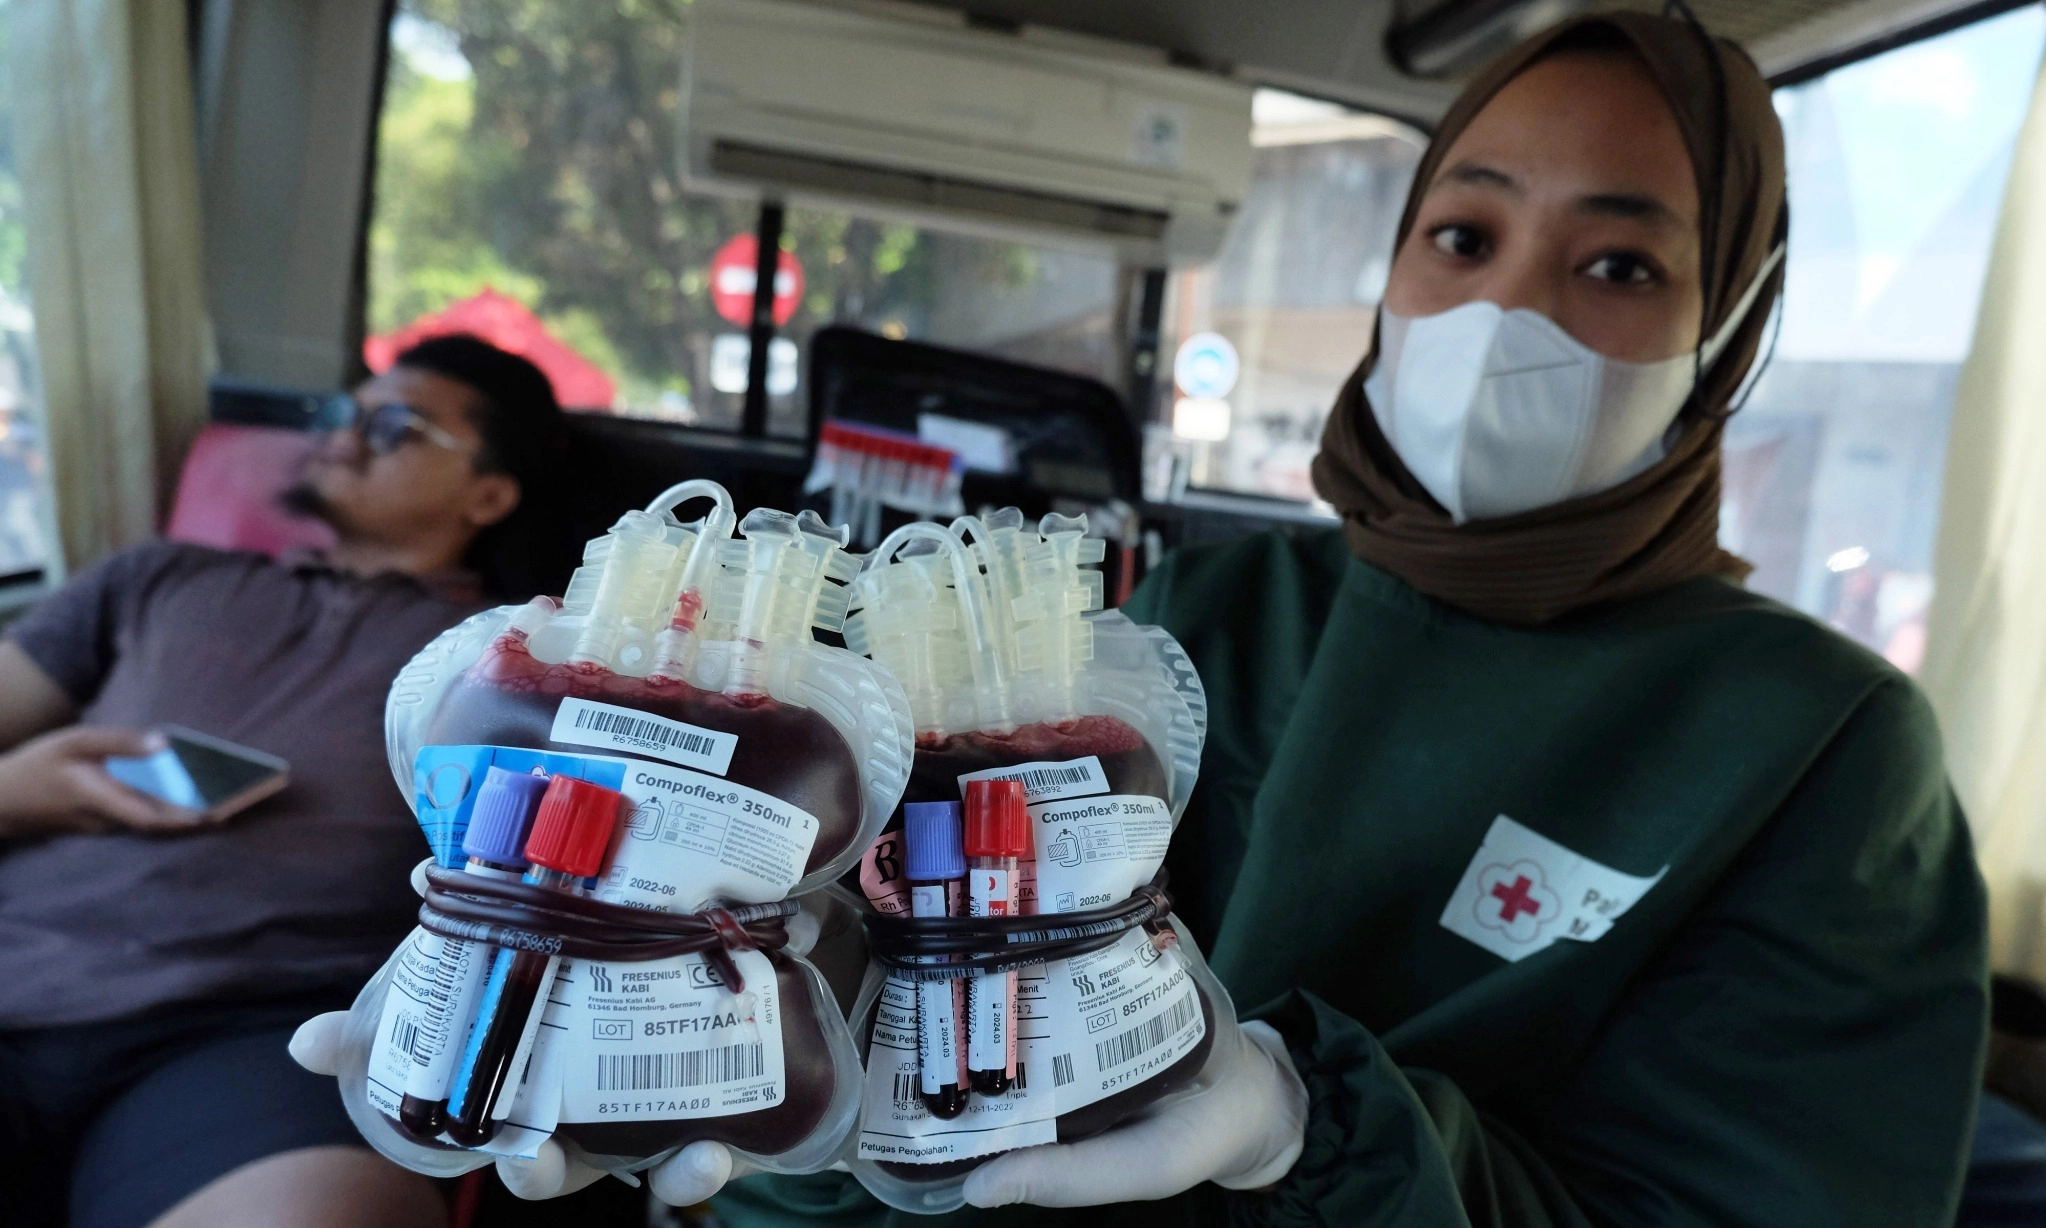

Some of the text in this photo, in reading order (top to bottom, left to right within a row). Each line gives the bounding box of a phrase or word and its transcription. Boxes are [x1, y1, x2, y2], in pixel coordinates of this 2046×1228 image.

[612, 735, 667, 752] R6758659
[425, 762, 472, 809] O
[1024, 786, 1062, 797] 6763892
[742, 800, 792, 828] 350ml
[1123, 803, 1155, 815] 350ml
[802, 819, 809, 829] 1
[874, 839, 900, 886] B
[629, 878, 676, 896] 2022-06
[880, 899, 897, 912] Rh
[1080, 894, 1111, 907] 2022-06
[989, 907, 1003, 916] tor
[500, 928, 562, 954] R6758659
[454, 950, 472, 983] KOTA
[1099, 957, 1135, 981] FRESENIUS
[622, 970, 681, 982] FRESENIUS
[1101, 977, 1120, 989] KABI
[622, 984, 649, 993] KABI
[588, 996, 623, 1005] Fresenius
[626, 996, 643, 1004] Kabi
[884, 991, 903, 1002] Durasi
[1091, 969, 1184, 1029] LOT 85TF17AA00
[669, 1000, 702, 1010] Germany
[765, 998, 773, 1025] 49176
[434, 985, 462, 1057] SURAKARTA
[598, 1012, 741, 1036] LOT 85TF17AA
[879, 1010, 906, 1024] Tanggal
[920, 997, 929, 1057] SURAKARTA
[993, 1012, 1001, 1044] 2024.03
[875, 1029, 917, 1044] Nama Petu
[941, 1027, 950, 1058] 2024.03
[893, 1101, 924, 1110] R6763
[968, 1103, 1014, 1113] 12-11-2022
[861, 1142, 895, 1154] Petugas
[899, 1145, 948, 1156] Pengolahan
